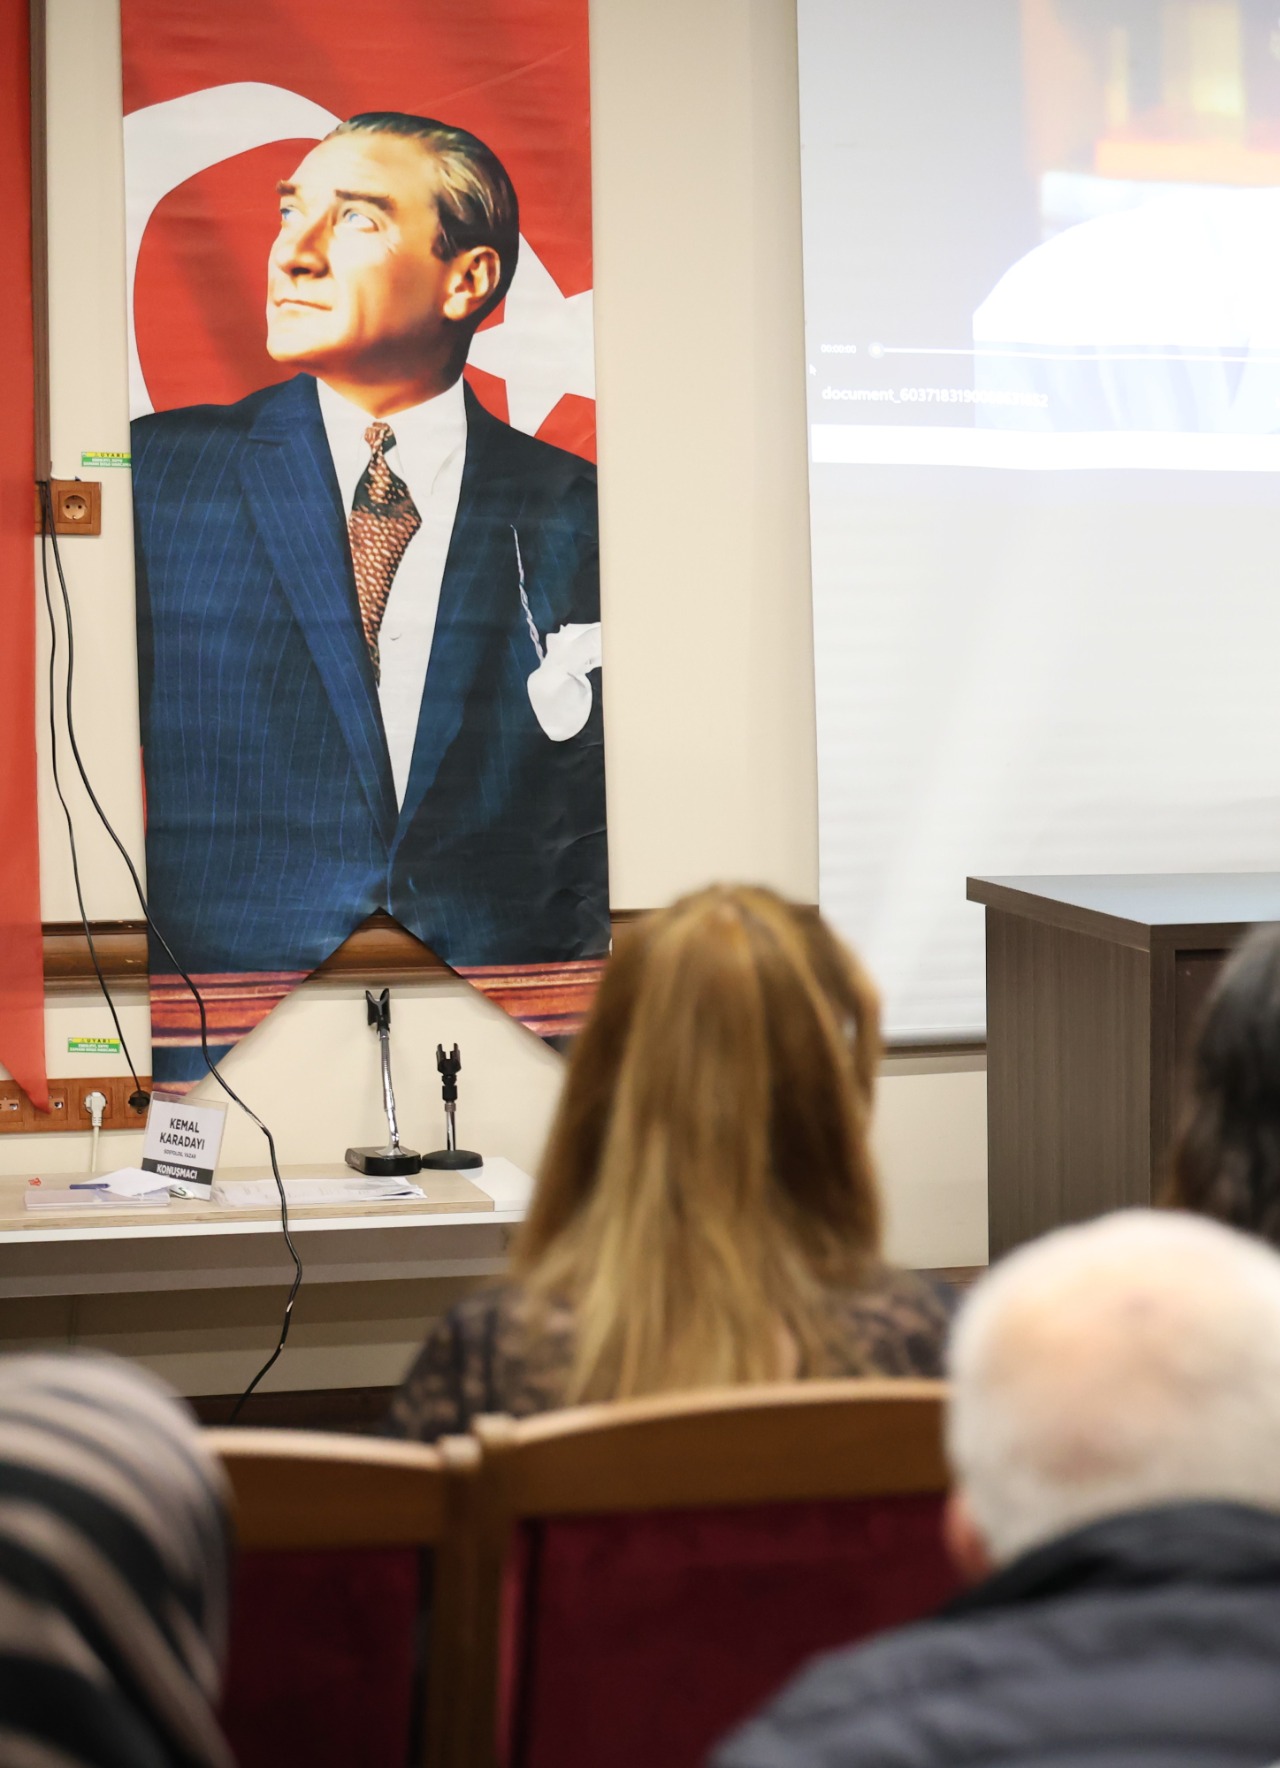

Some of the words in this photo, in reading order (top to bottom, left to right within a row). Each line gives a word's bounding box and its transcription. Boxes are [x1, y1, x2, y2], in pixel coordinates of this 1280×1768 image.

[169, 1118, 200, 1133] KEMAL
[159, 1132, 205, 1150] KARADAYI
[156, 1164, 198, 1180] KONUŞMACI
